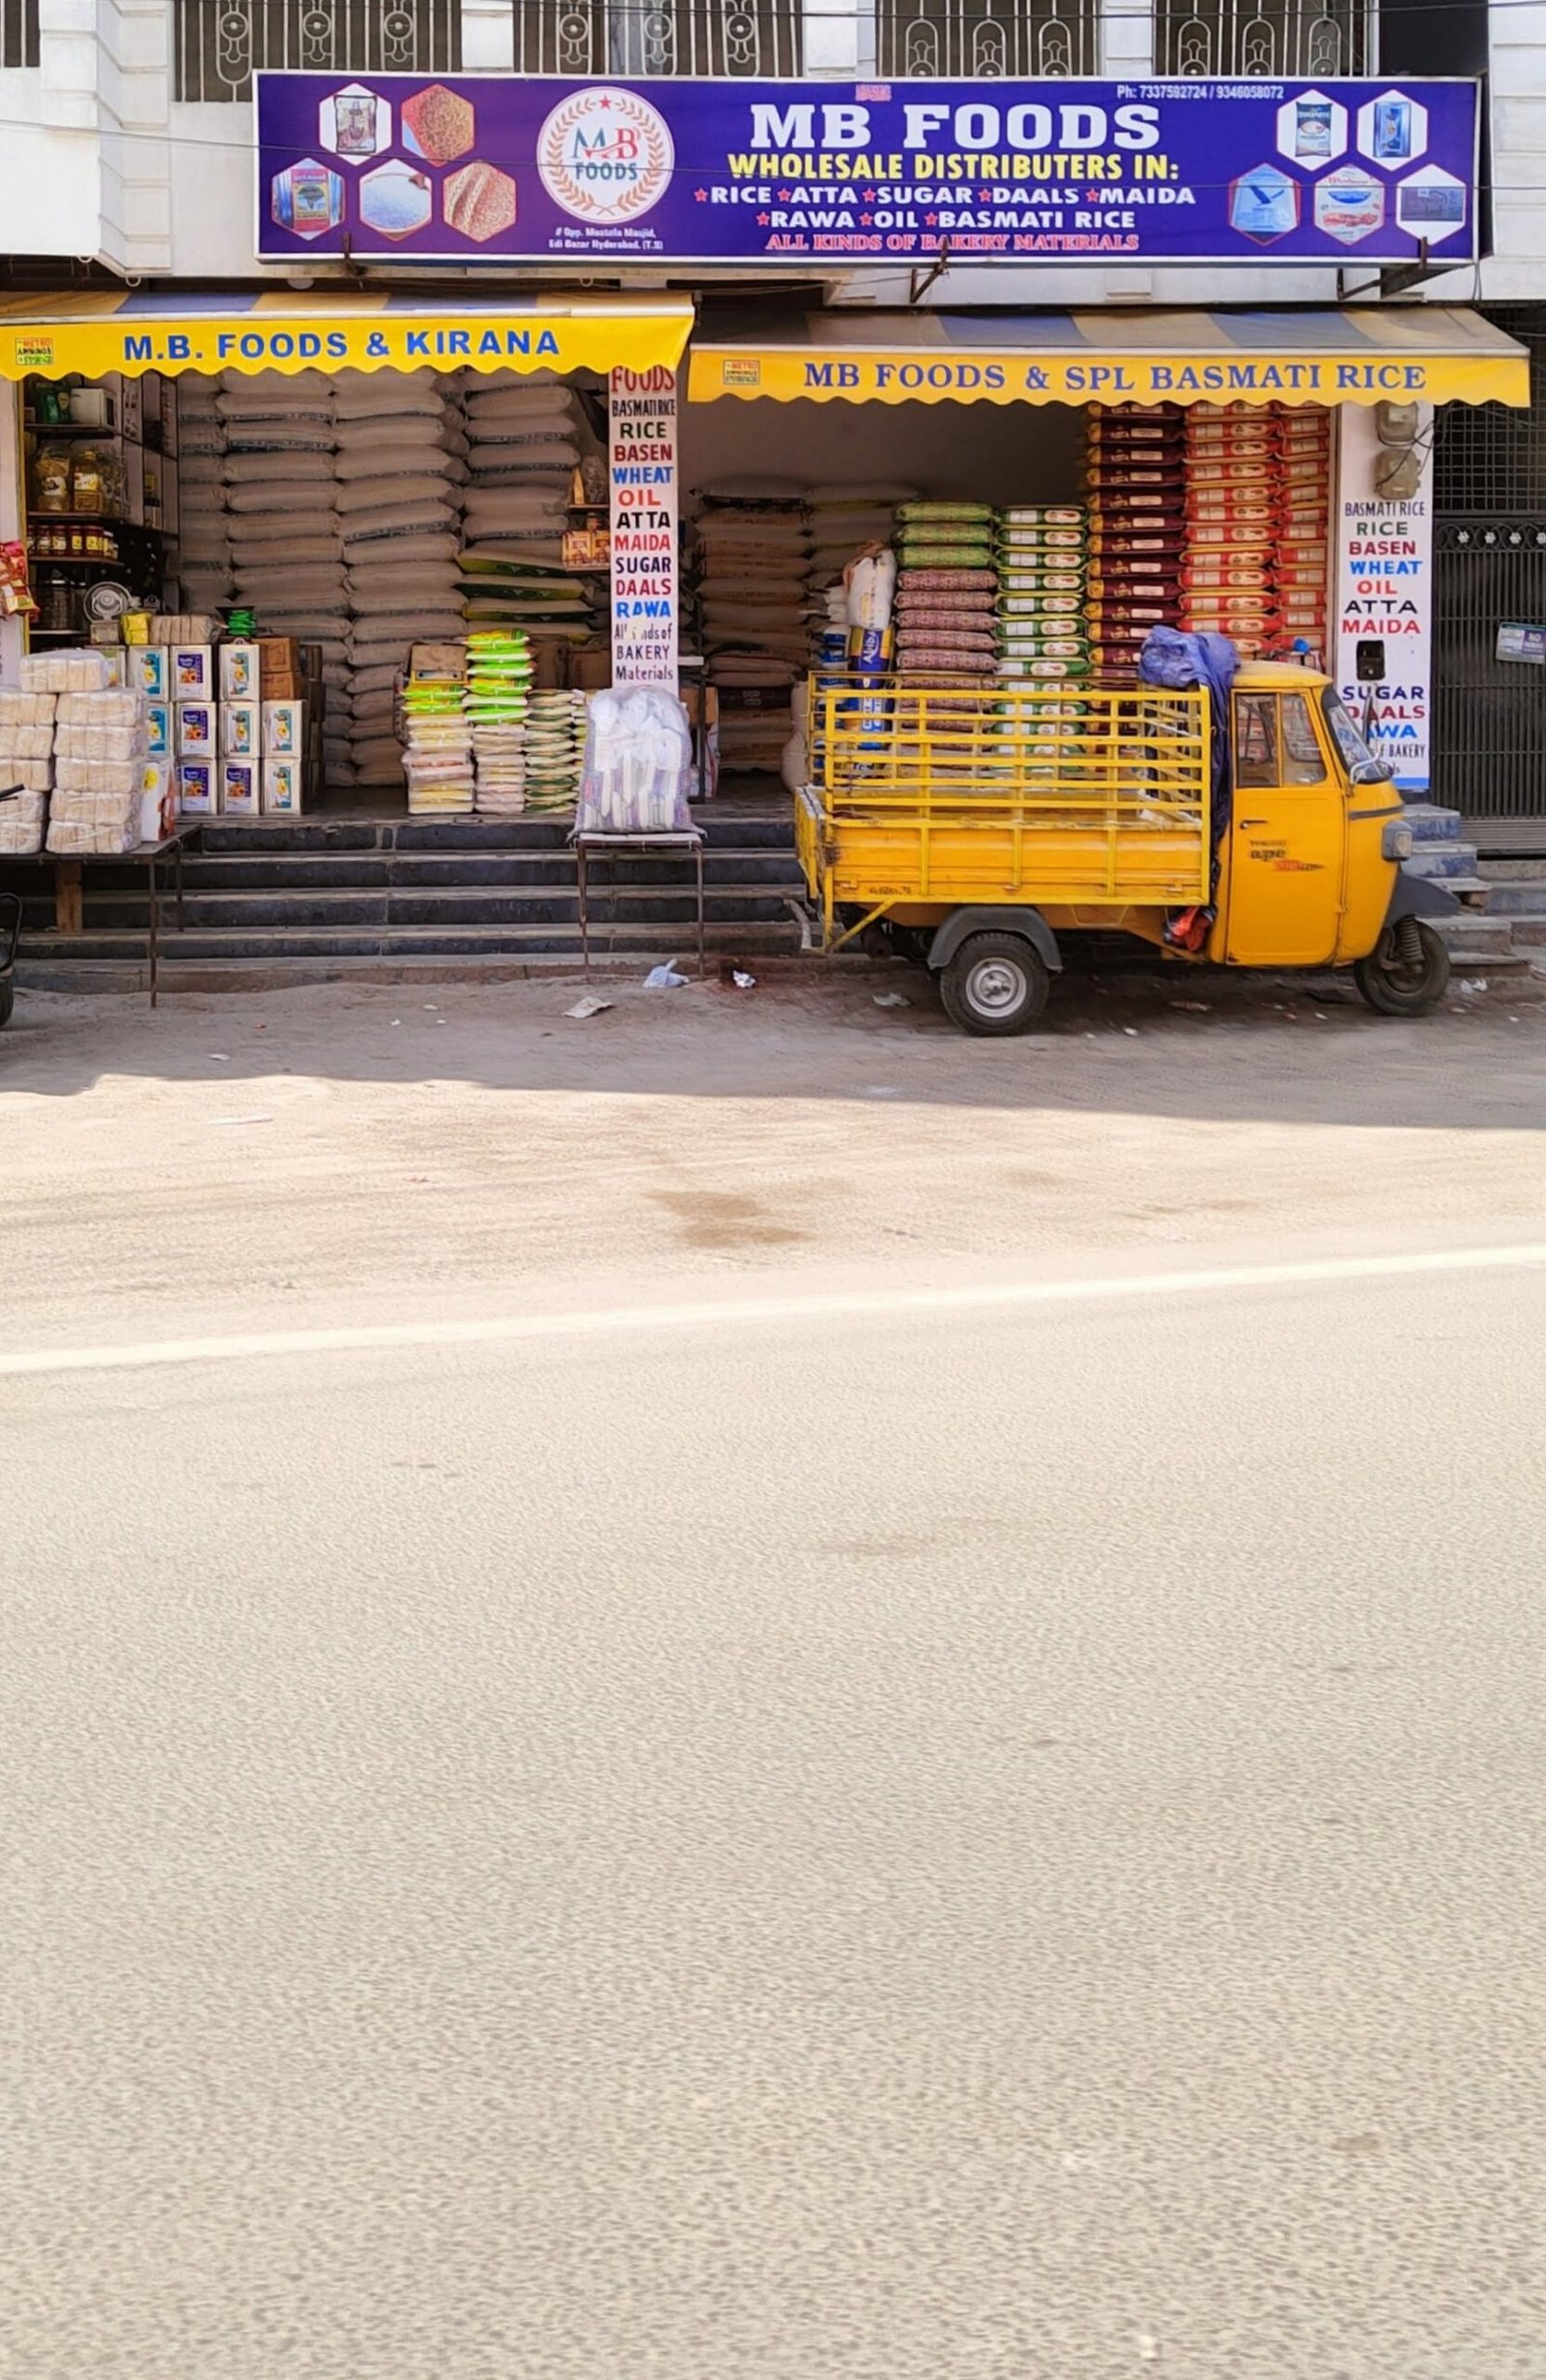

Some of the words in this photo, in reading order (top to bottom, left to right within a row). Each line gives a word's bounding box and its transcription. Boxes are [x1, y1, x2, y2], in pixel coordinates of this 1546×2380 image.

[1116, 85, 1137, 99] Ph:
[750, 104, 872, 149] MB
[902, 104, 1160, 149] FOODS
[575, 161, 638, 181] FOODS
[728, 154, 903, 179] WHOLESALE
[915, 154, 1123, 179] DISTRIBUTERS
[1134, 155, 1179, 179] IN:
[710, 186, 771, 204] RICE
[789, 186, 858, 204] ATTA
[876, 186, 972, 205] SUGAR
[991, 186, 1079, 205] DAALS
[1099, 187, 1195, 205] MAIDA
[770, 211, 854, 228] RAWA
[873, 211, 919, 228] OIL
[938, 211, 1064, 228] BASMATI
[1074, 211, 1136, 228] RICE
[766, 234, 810, 250] ALL
[813, 234, 882, 250] KINDS
[886, 234, 917, 250] OF
[921, 234, 1010, 250] BAKERY
[1014, 234, 1139, 250] MATERIALS
[124, 335, 203, 360] M.B.
[217, 332, 348, 358] FOODS
[366, 331, 389, 357] &
[407, 330, 560, 356] KIRANA
[612, 365, 675, 392] FOODS
[804, 362, 860, 387] MB
[874, 363, 1006, 389] FOODS
[1025, 366, 1050, 390] &
[1066, 366, 1135, 391] SPL
[1150, 365, 1322, 390] BASMATI
[1336, 365, 1427, 389] RICE
[612, 399, 657, 416] BASMATI
[658, 398, 675, 416] RICE
[619, 422, 667, 439] RICE
[615, 444, 673, 462] BASEN
[613, 467, 673, 484] WHEAT
[618, 489, 662, 506] OIL
[1345, 502, 1396, 517] BASMATI
[1400, 501, 1425, 516] RICE
[616, 511, 671, 529] ATTA
[1357, 522, 1408, 535] RICE
[615, 534, 671, 551] MAIDA
[1349, 541, 1416, 556] BASEN
[616, 557, 672, 574] SUGAR
[1350, 560, 1422, 575] WHEAT
[616, 579, 672, 595] DAALS
[1357, 580, 1397, 594] OIL
[616, 601, 671, 617] RAWA
[1345, 600, 1418, 615] ATTA
[661, 622, 673, 640] of
[1342, 619, 1421, 634] MAIDA
[616, 645, 670, 660] BAKERY
[616, 665, 673, 680] Materials
[1342, 685, 1424, 701] SUGAR
[1389, 743, 1426, 759] BAKERY
